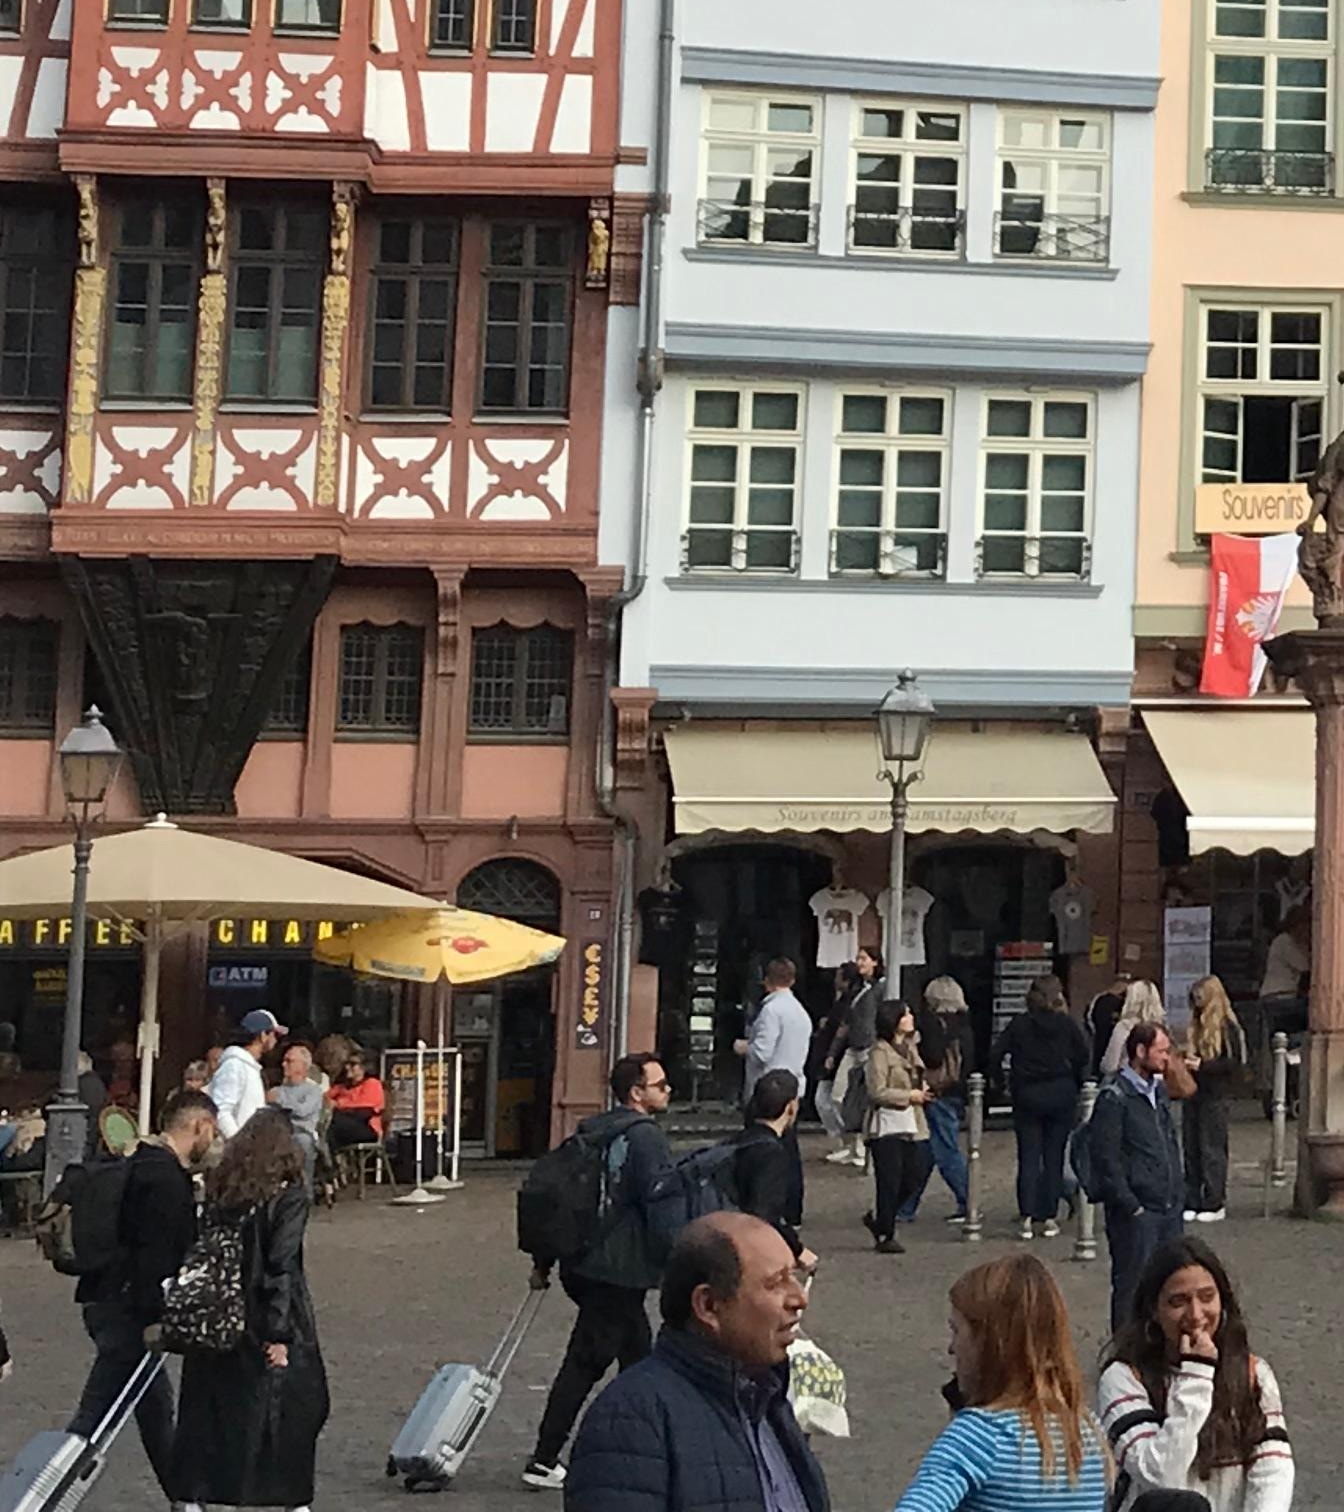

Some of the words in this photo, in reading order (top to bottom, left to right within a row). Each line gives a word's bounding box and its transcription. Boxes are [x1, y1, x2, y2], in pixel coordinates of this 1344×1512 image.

[1222, 488, 1304, 522] Souvenirs
[776, 805, 862, 823] Souvenirs
[908, 805, 1017, 824] amstagsberg
[0, 919, 134, 944] AFFEE
[218, 920, 334, 944] CHAN
[228, 967, 268, 981] ATM
